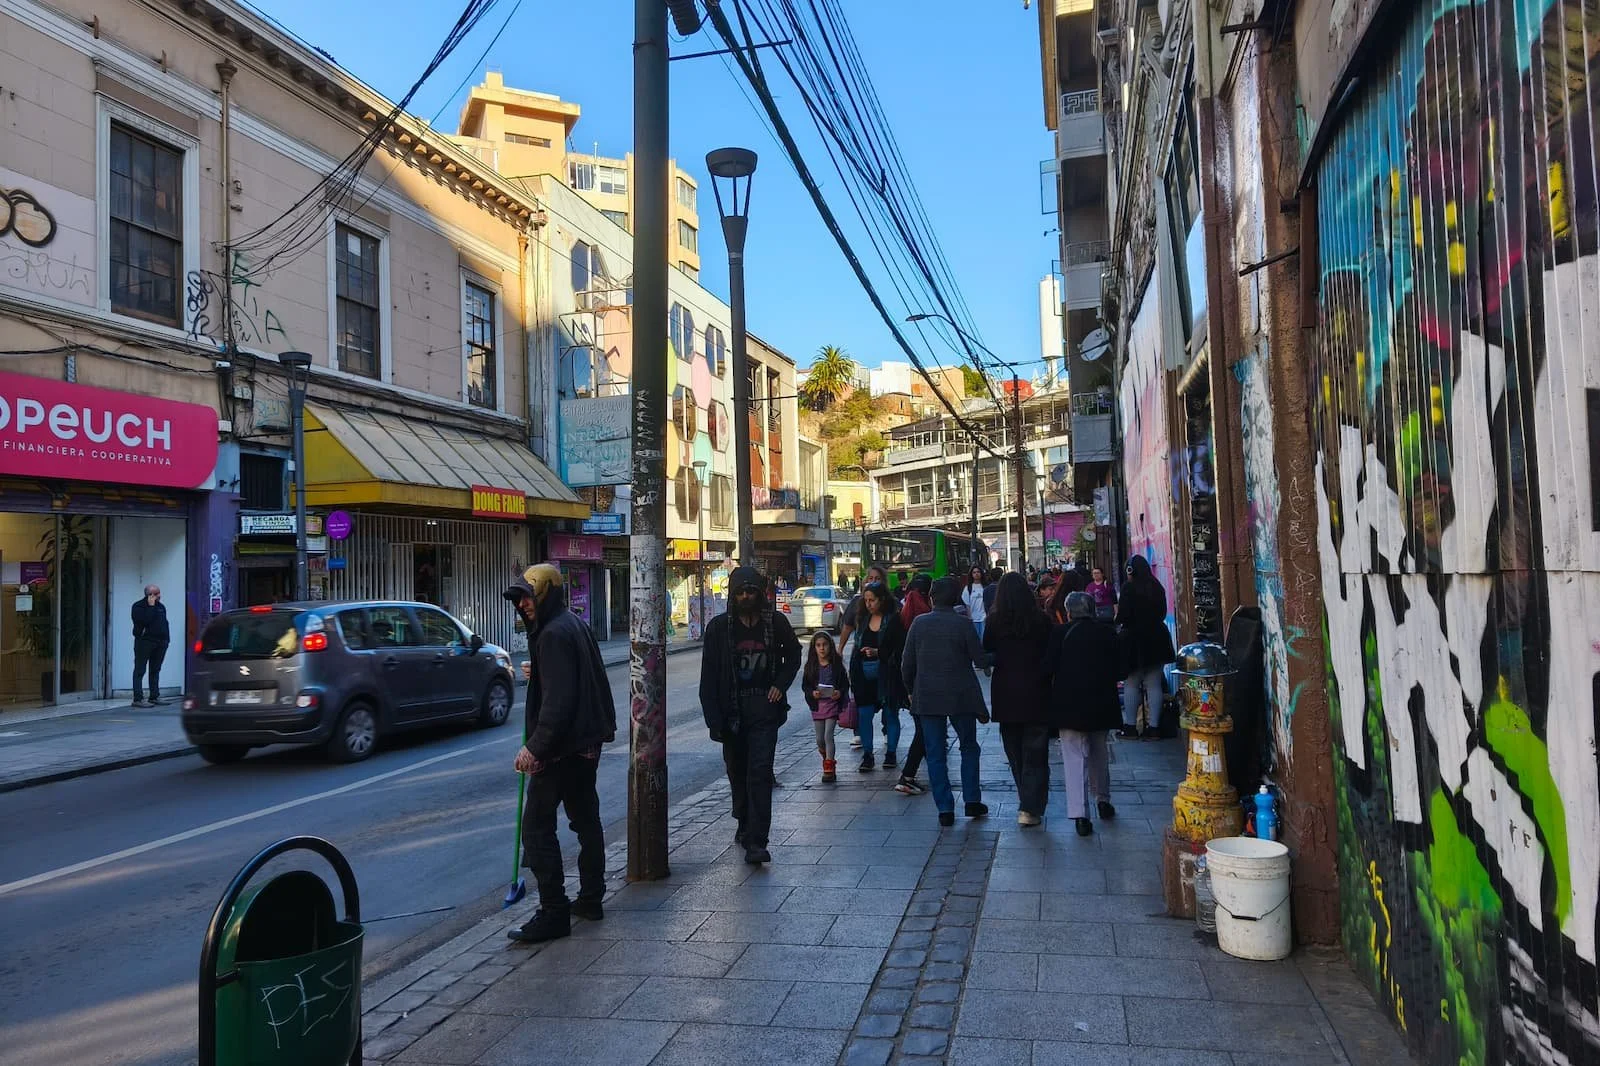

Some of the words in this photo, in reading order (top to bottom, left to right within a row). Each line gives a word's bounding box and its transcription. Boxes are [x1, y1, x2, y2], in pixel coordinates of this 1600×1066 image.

[3, 440, 85, 457] FINANCIERA
[91, 450, 172, 466] COOPERATIVA
[473, 491, 501, 512] DONG
[502, 494, 525, 514] FANG
